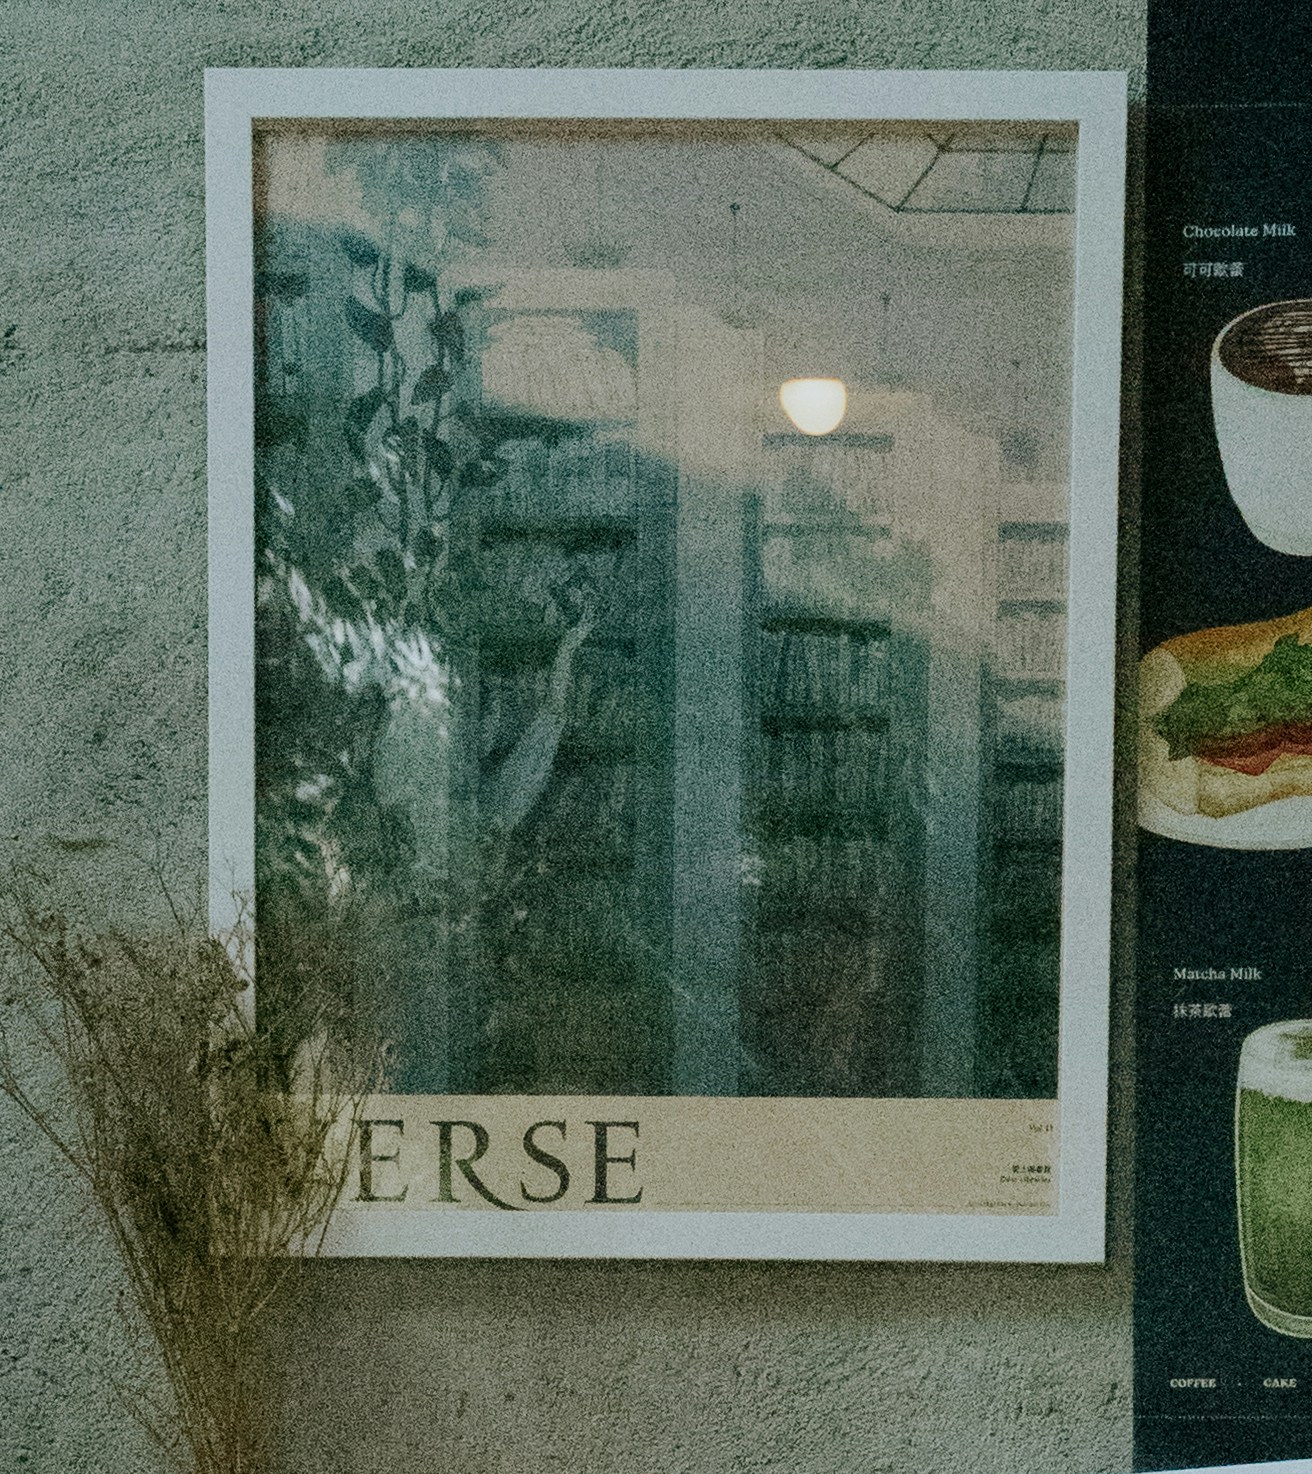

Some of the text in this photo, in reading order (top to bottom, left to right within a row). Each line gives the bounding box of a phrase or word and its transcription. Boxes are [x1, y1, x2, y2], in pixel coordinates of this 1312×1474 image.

[1183, 222, 1296, 239] Chocolate Milk
[1173, 966, 1262, 982] Matcha Milk
[355, 1119, 644, 1211] ERSE
[1169, 1377, 1217, 1390] COFFEE
[1263, 1377, 1297, 1390] CAKE
